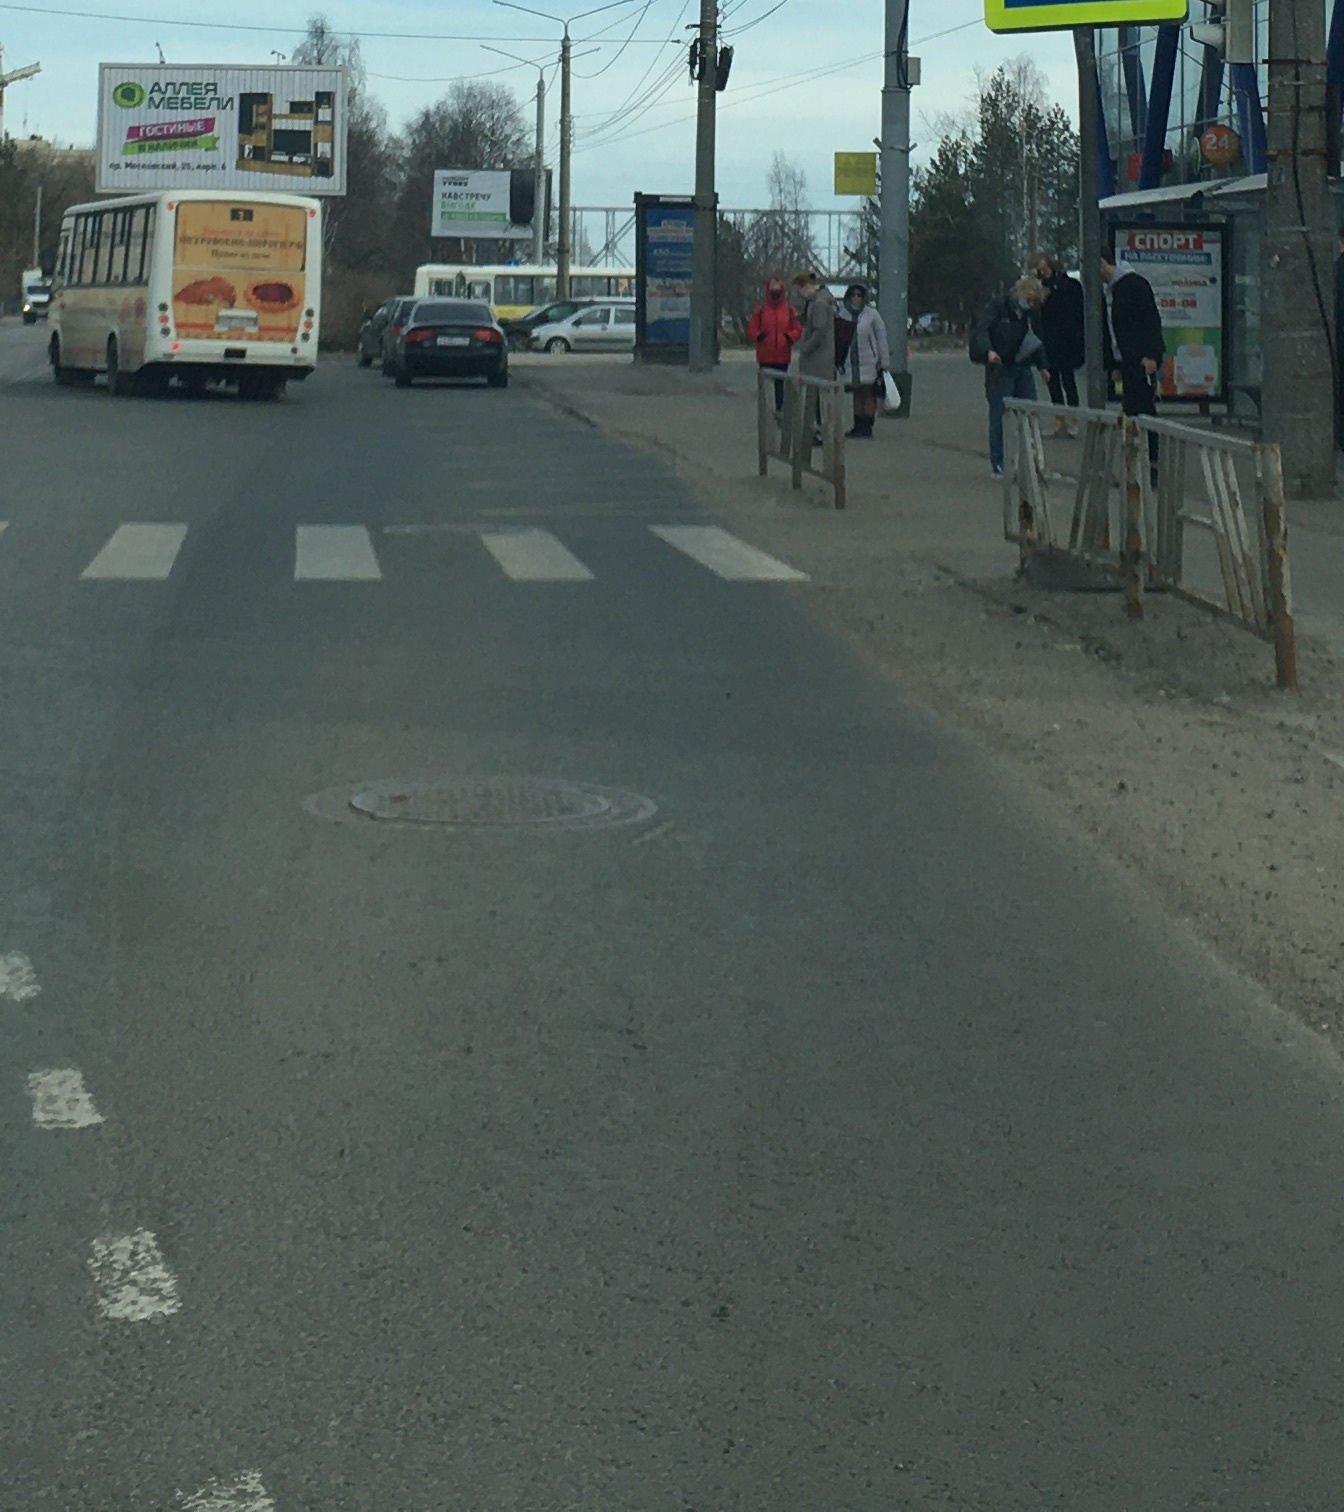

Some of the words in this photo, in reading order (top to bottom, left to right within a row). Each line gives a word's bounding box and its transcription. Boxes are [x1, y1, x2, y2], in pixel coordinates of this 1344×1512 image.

[149, 81, 218, 96] АЛЛЕЯ
[147, 96, 234, 110] МЕБЕЛИ
[139, 121, 205, 137] ГОСТИНЫЕ
[1205, 133, 1229, 149] 24
[441, 191, 492, 201] НАВСТРЕЧУ
[1134, 233, 1198, 250] СПОРТ
